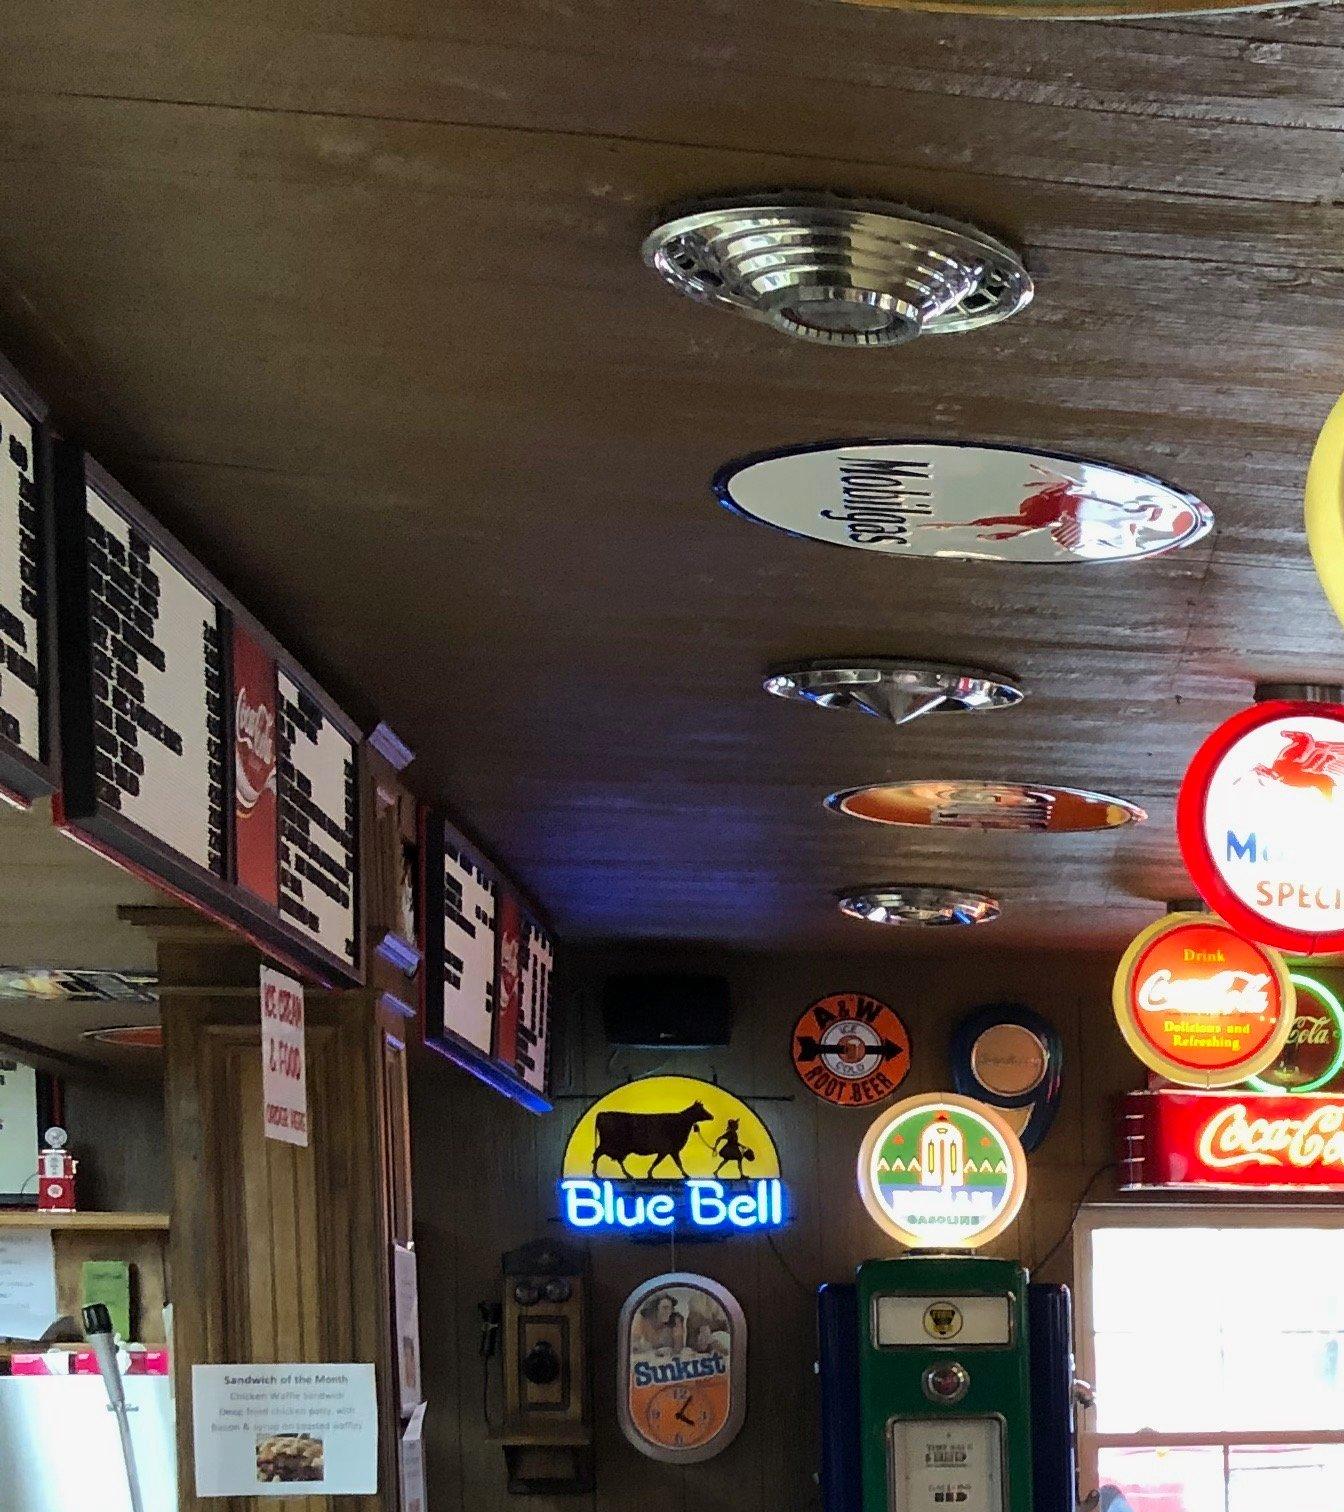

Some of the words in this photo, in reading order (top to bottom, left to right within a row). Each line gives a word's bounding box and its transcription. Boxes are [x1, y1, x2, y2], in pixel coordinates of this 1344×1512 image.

[821, 457, 932, 545] Mobilgas
[1184, 949, 1225, 963] Drink
[813, 998, 883, 1030] A&W
[1164, 1021, 1221, 1034] Delicious
[1226, 1023, 1250, 1034] and
[1173, 1034, 1241, 1051] Refreshing
[804, 1065, 848, 1101] ROOT
[851, 1071, 894, 1102] BEER
[562, 1180, 674, 1227] Blue
[686, 1179, 782, 1226] Bell
[224, 1375, 277, 1385] Sandwich
[280, 1374, 292, 1385] of
[294, 1374, 312, 1385] the
[315, 1374, 349, 1385] Month
[635, 1352, 726, 1386] Sunkist
